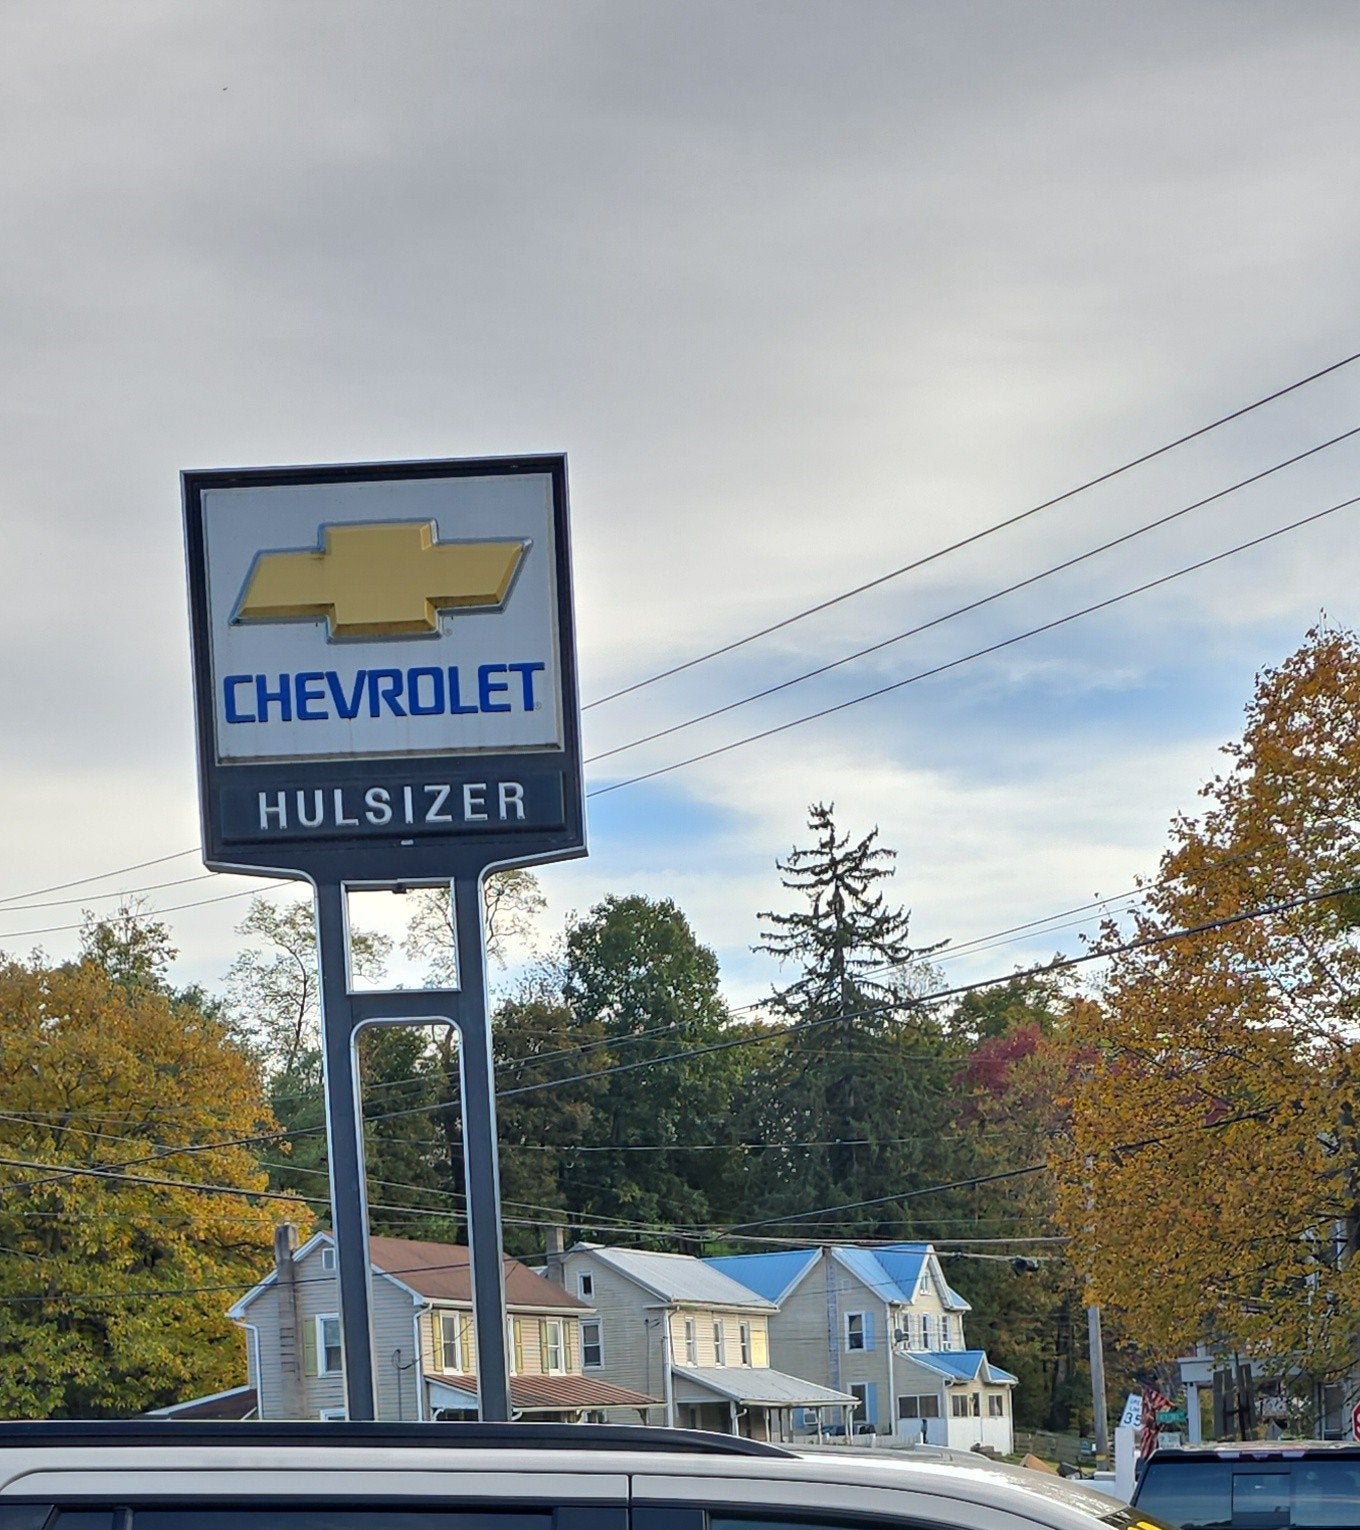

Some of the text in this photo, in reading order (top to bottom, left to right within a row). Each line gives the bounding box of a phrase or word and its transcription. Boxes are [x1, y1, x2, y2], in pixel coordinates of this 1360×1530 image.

[223, 662, 545, 724] CHEVROLET
[257, 781, 528, 831] HULSIZER
[1123, 1411, 1142, 1427] 35
